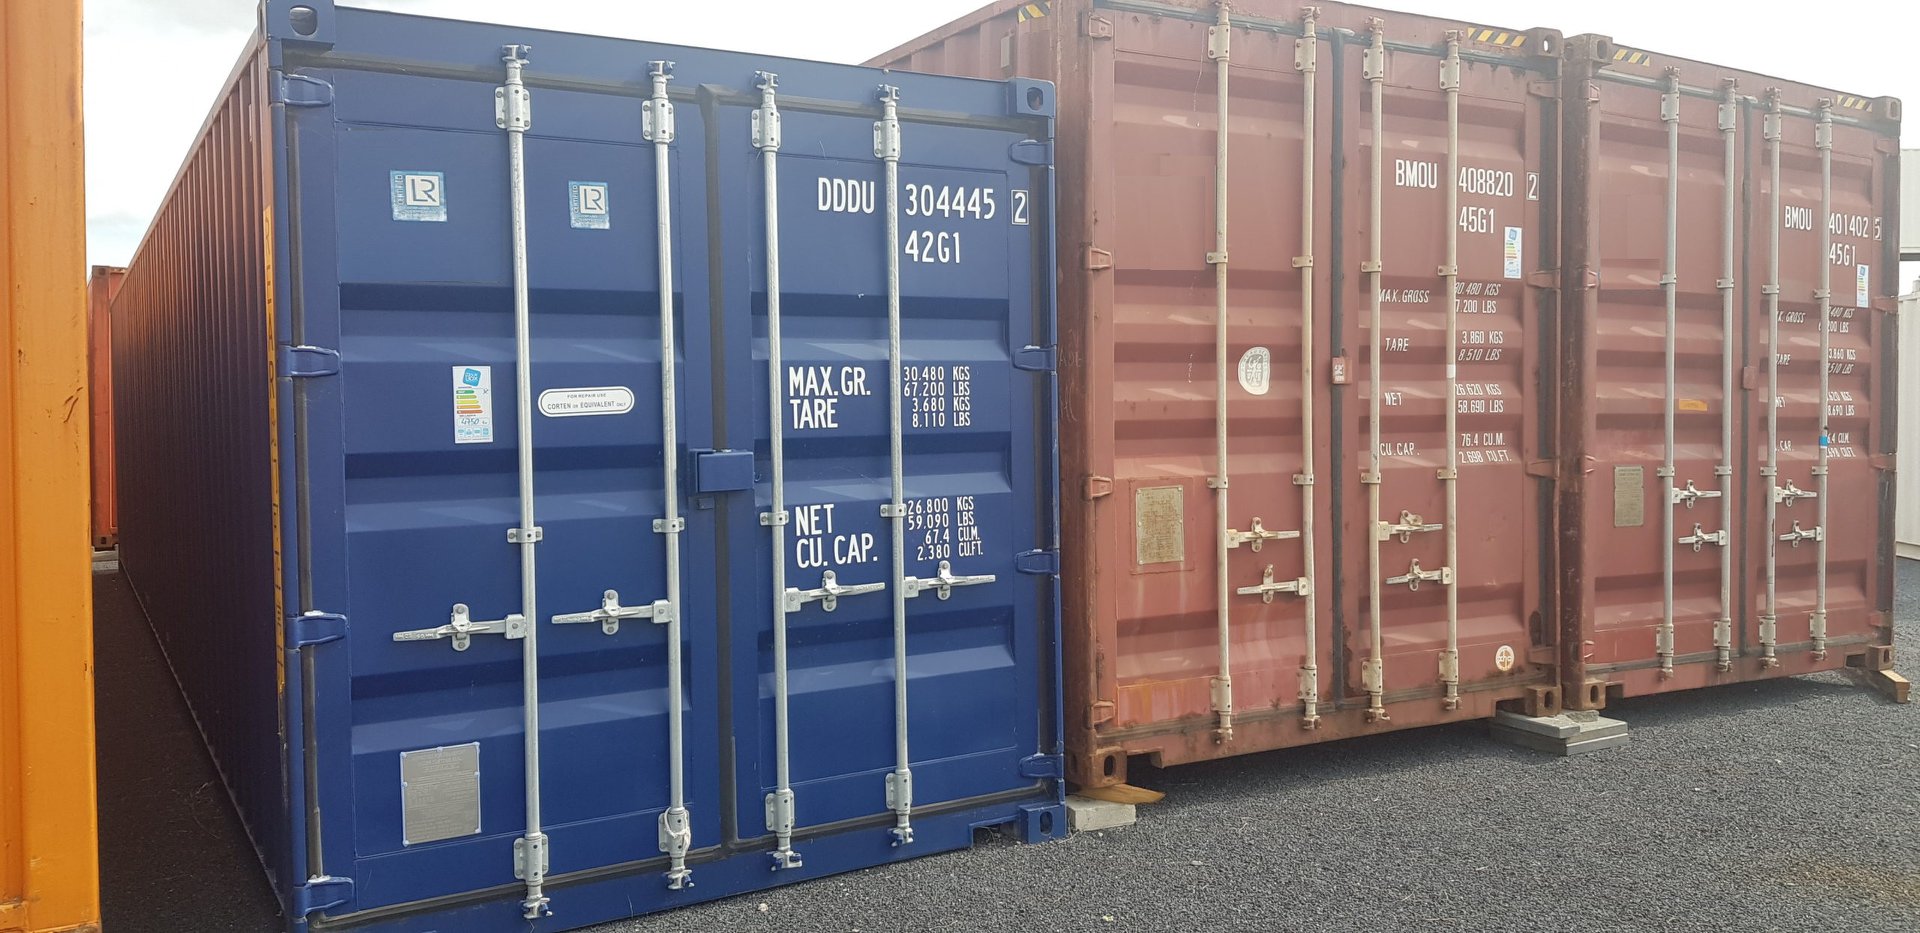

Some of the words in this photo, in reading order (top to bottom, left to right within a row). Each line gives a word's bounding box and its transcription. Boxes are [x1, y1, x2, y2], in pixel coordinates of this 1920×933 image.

[1395, 159, 1438, 189] BMOU
[1459, 166, 1513, 197] 408820
[1528, 174, 1538, 199] 2
[411, 179, 437, 202] LR
[584, 188, 604, 211] LR
[817, 177, 875, 214] DDDU
[905, 183, 995, 220] 304445
[1013, 192, 1027, 223] 2
[1459, 206, 1494, 234] 45G1
[1785, 205, 1812, 231] BMOU
[1829, 212, 1869, 238] 401402
[904, 230, 960, 264] 42G1
[1829, 242, 1856, 267] 45G1
[1484, 283, 1501, 295] KGS
[1455, 299, 1478, 313] 7.200
[1482, 300, 1496, 313] LBS
[1840, 321, 1849, 333] LBS
[1385, 338, 1409, 352] TARE
[1462, 331, 1484, 344] 3.860
[1489, 331, 1503, 344] KGS
[1458, 348, 1482, 361] 8.510
[1485, 348, 1502, 361] LBS
[903, 366, 945, 381] 30.480
[952, 366, 970, 381] KGS
[903, 382, 945, 397] 67.200
[953, 381, 970, 396] LBS
[1384, 392, 1402, 406] NET
[1485, 383, 1502, 395] KGS
[547, 402, 571, 410] CORTEN
[580, 400, 615, 408] EQUIVALENT
[790, 398, 838, 429] TARE
[912, 397, 945, 412] 3.680
[953, 397, 970, 411] KGS
[1457, 400, 1484, 413] 58.690
[1490, 399, 1504, 413] LBS
[1828, 405, 1843, 416] 8.690
[1845, 405, 1855, 416] LBS
[912, 413, 945, 428] 8.110
[953, 412, 971, 427] LBS
[1461, 433, 1479, 447] 76.4
[795, 503, 834, 537] NET
[907, 498, 948, 515] 26.800
[957, 496, 974, 511] KGS
[908, 513, 949, 531] 59.090
[957, 511, 974, 526] LBS
[796, 538, 828, 569] CU.
[833, 532, 878, 565] CAP.
[925, 528, 950, 545] 67.4
[958, 526, 980, 542] CU.M.
[917, 544, 950, 561] 2.380
[958, 541, 983, 557] CU.FT.
